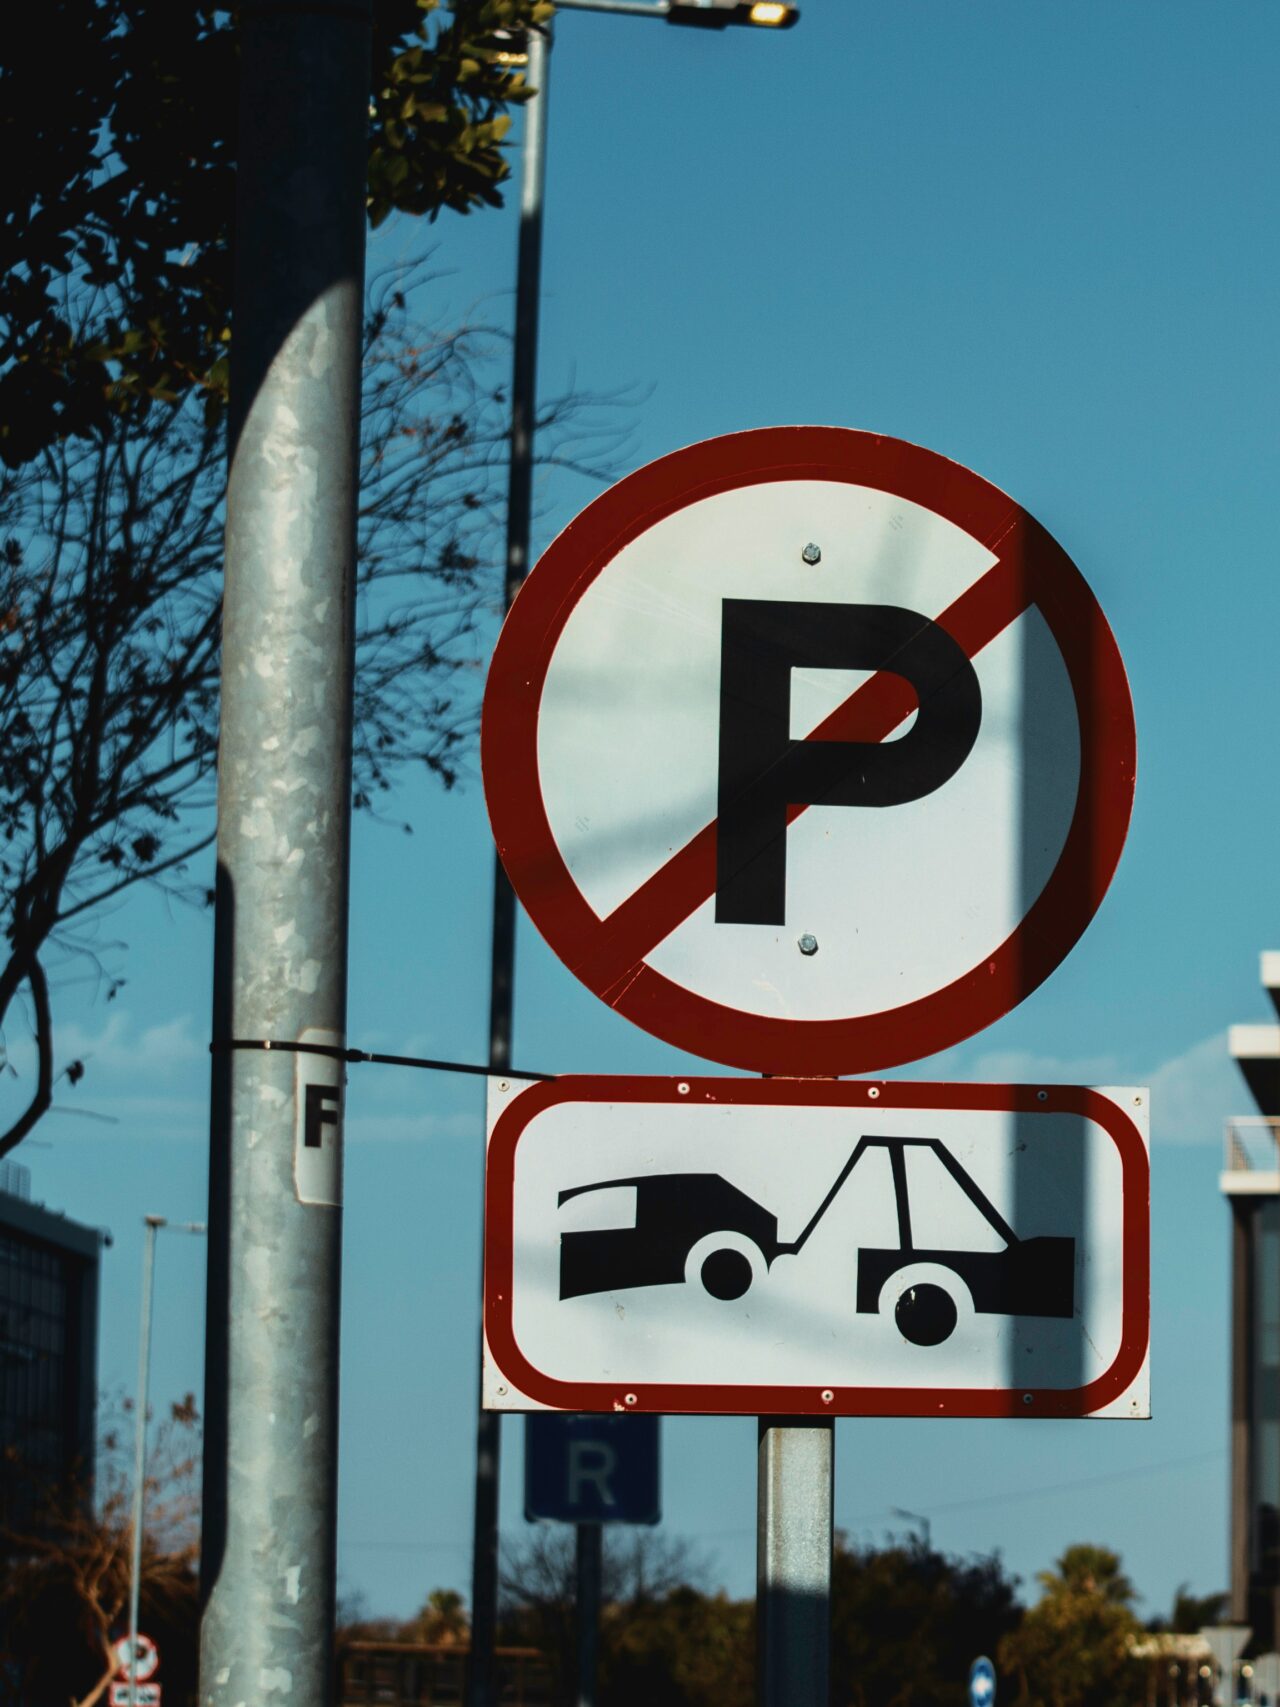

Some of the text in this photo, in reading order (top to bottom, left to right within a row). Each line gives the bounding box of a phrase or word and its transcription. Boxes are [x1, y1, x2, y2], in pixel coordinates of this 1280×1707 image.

[714, 597, 983, 926] P
[304, 1083, 341, 1148] F
[568, 1440, 617, 1505] R
